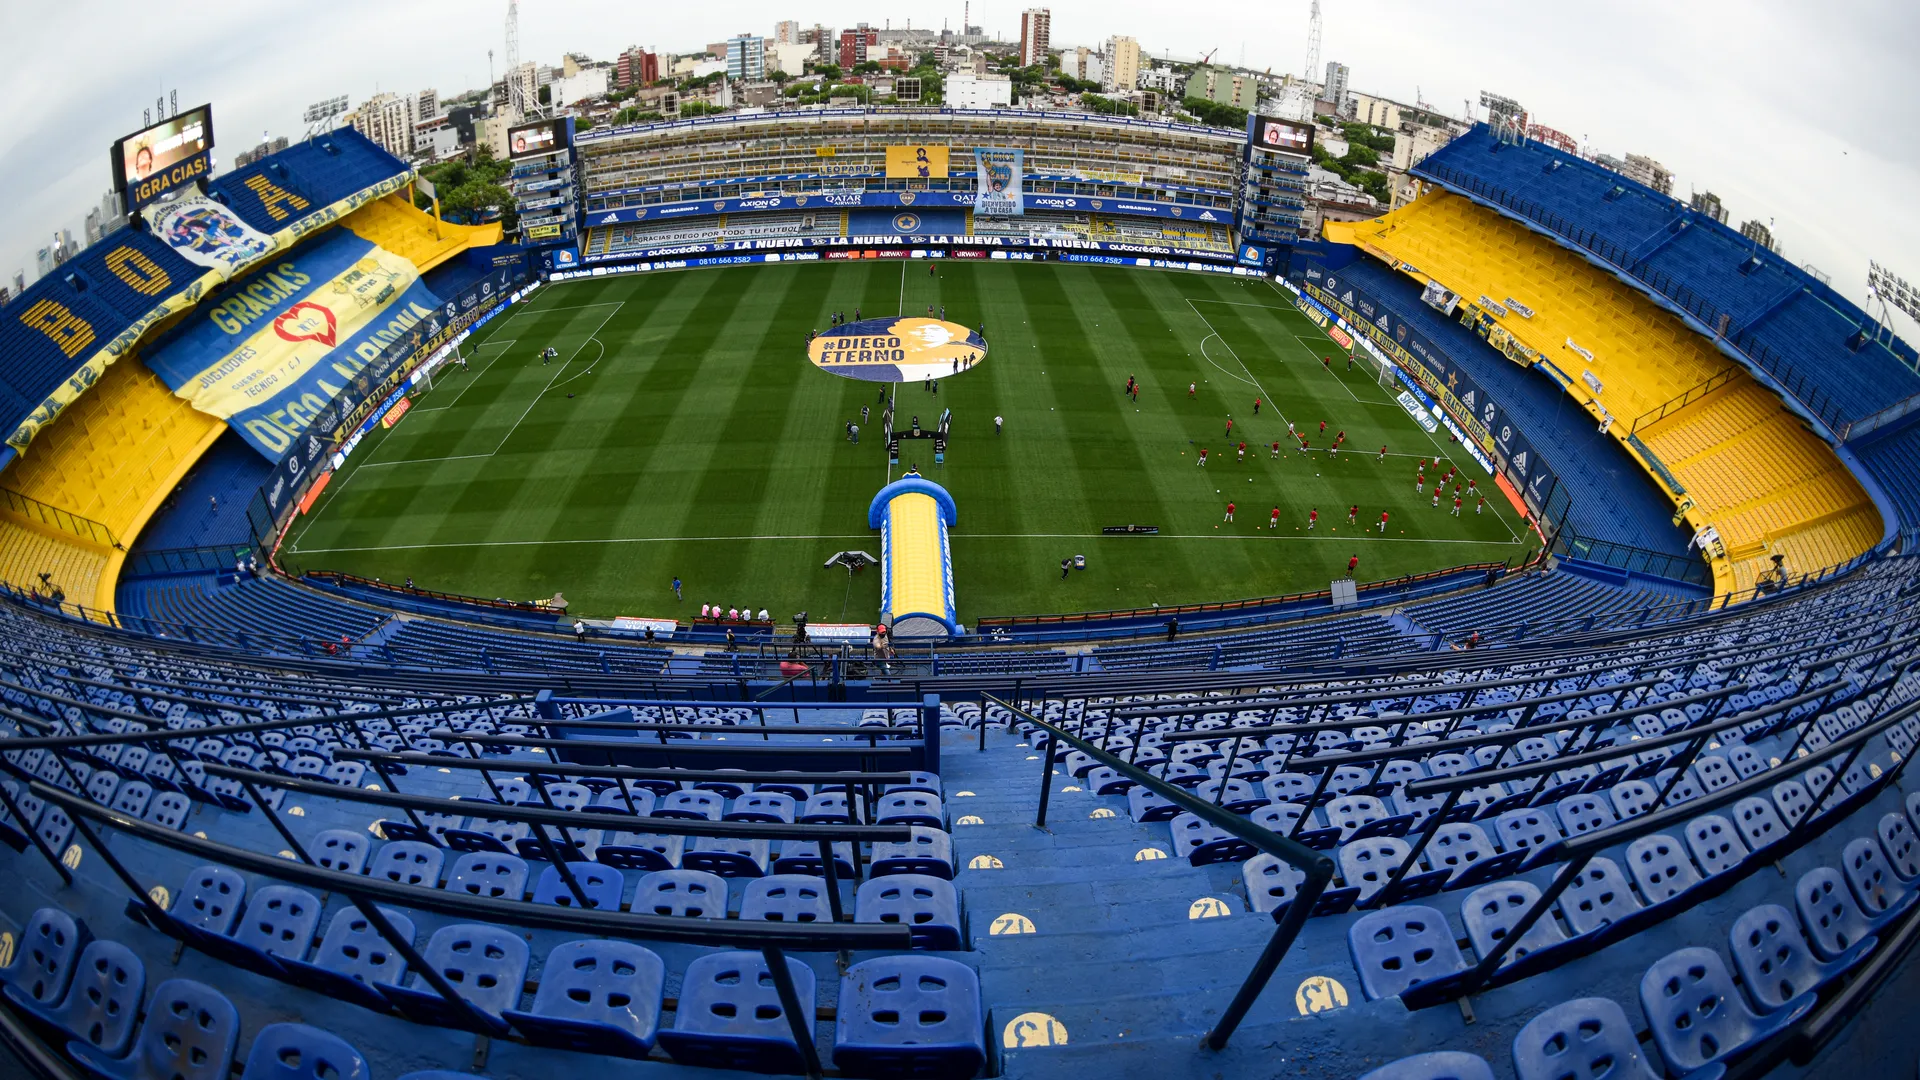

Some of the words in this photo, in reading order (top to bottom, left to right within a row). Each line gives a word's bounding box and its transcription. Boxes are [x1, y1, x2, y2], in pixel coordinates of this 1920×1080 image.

[820, 166, 874, 174] LEOPARDI
[639, 235, 671, 243] GRACIAS
[734, 241, 748, 250] LA
[756, 239, 804, 249] NUEVA
[853, 236, 903, 244] NUEVA
[930, 236, 948, 244] LA
[953, 236, 1002, 245] NUEVA
[1030, 239, 1048, 247] LA
[1052, 240, 1100, 249] NUEVA
[648, 246, 707, 257] autocrédito
[1108, 243, 1170, 254] autocrédito
[1193, 250, 1234, 260] Bariloche
[602, 252, 644, 260] Bariloche
[699, 258, 716, 266] 0810
[797, 252, 818, 260] Redondo
[666, 260, 686, 268] Redondo
[1166, 261, 1186, 269] Redondo
[210, 262, 311, 335] GRACIAS
[462, 294, 477, 308] QATAR
[1341, 296, 1354, 308] adidas
[1300, 301, 1307, 312] LA
[1306, 304, 1322, 324] NUEVA
[1358, 300, 1374, 313] QATAR
[476, 316, 486, 328] 0810
[486, 310, 495, 320] 666
[494, 304, 505, 315] 2582
[1376, 320, 1389, 333] adidas
[823, 338, 900, 350] #DIEGO
[820, 349, 904, 364] ETERNO
[1412, 340, 1426, 357] QATAR
[1427, 354, 1446, 374] AIRWAYS
[200, 345, 257, 389] JUGADORES
[374, 359, 390, 378] QATAR
[1319, 290, 1340, 312] PUEBLO
[1342, 306, 1350, 318] NO
[1380, 334, 1397, 354] QUIEN
[1408, 354, 1421, 373] HIZO
[1444, 392, 1468, 422] GRACIAS
[1468, 420, 1486, 442] DIEGO
[231, 368, 265, 391] CUERPO
[243, 374, 278, 399] TECNICO
[341, 378, 394, 438] JUGADOR
[412, 349, 424, 362] 12
[428, 331, 449, 352] PTE
[1397, 370, 1407, 383] 0810
[1406, 379, 1416, 392] 666
[1415, 388, 1426, 402] 2582
[342, 402, 355, 419] adidas
[371, 410, 384, 424] 0810
[383, 400, 394, 413] 666
[392, 387, 405, 404] 2582
[1462, 396, 1476, 413] adidas
[321, 412, 337, 432] QATAR
[309, 442, 322, 461] adidas
[1513, 458, 1526, 477] adidas
